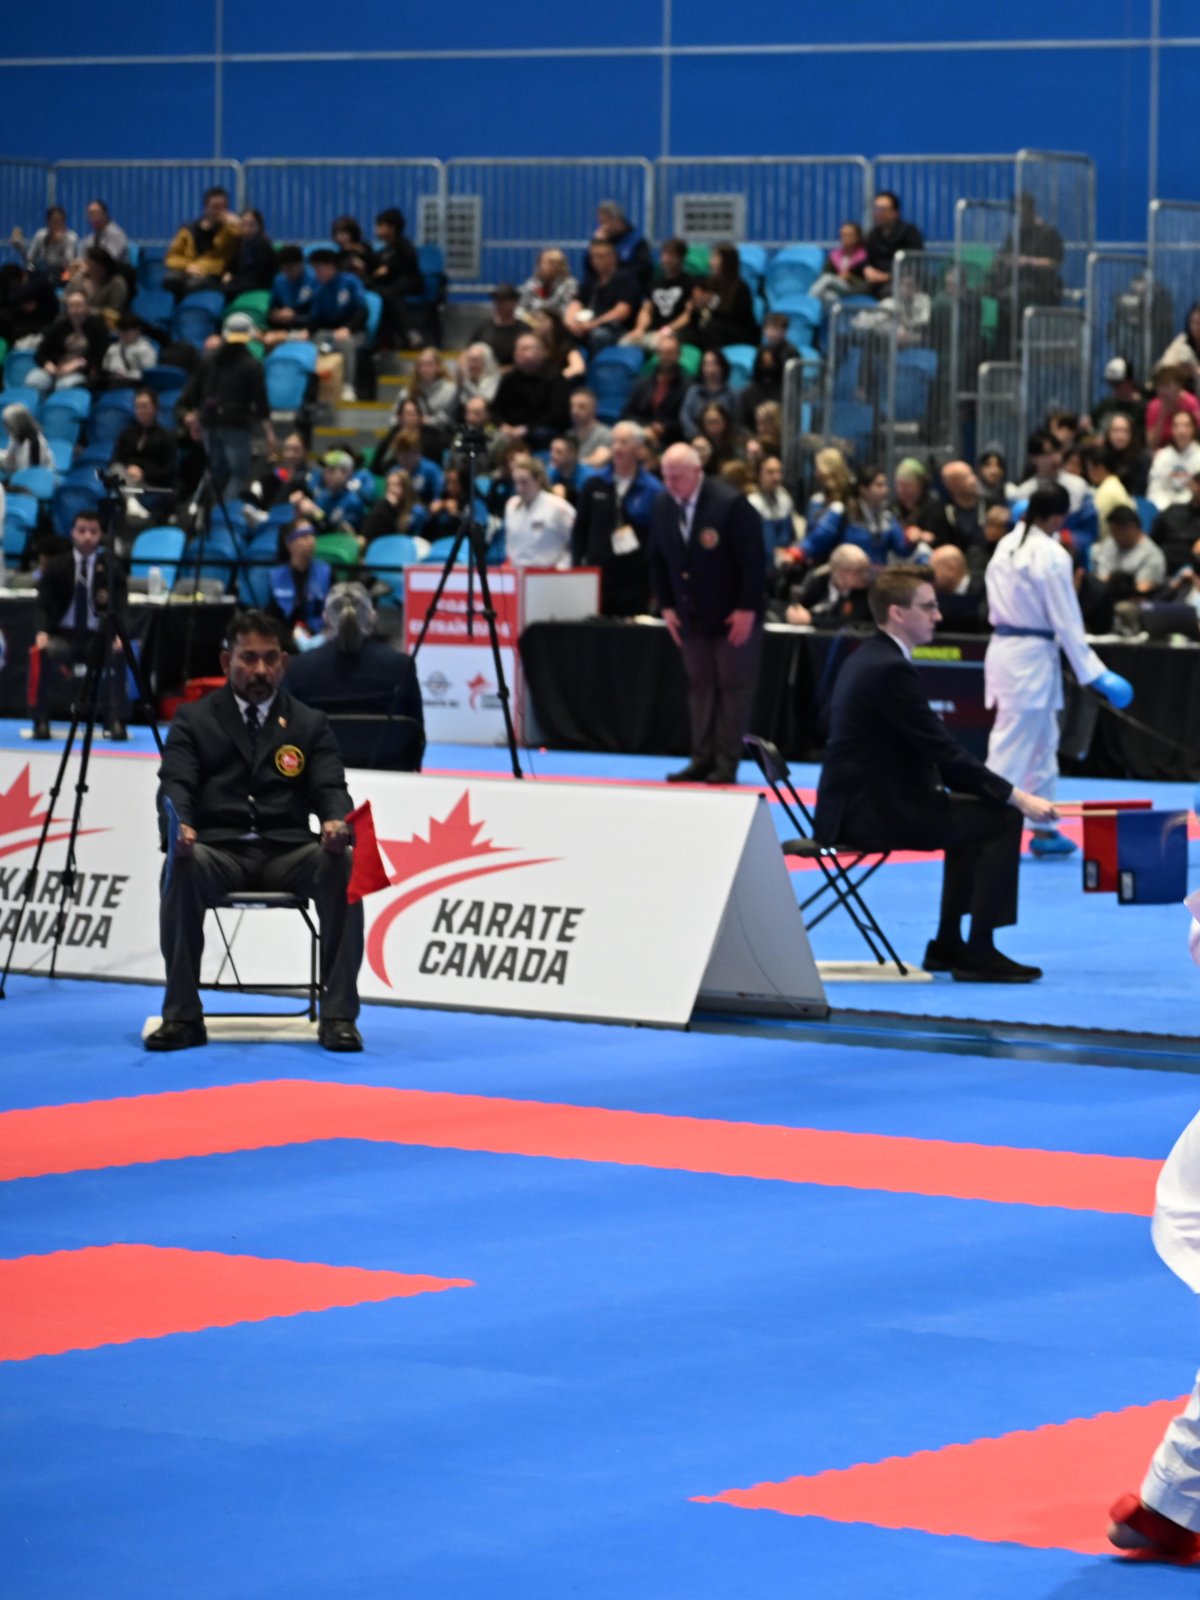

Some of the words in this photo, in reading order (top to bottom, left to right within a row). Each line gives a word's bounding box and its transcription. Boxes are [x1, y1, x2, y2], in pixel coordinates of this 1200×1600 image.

[0, 908, 113, 949] ANADA
[432, 898, 585, 943] KARATE
[418, 940, 569, 985] CANADA
